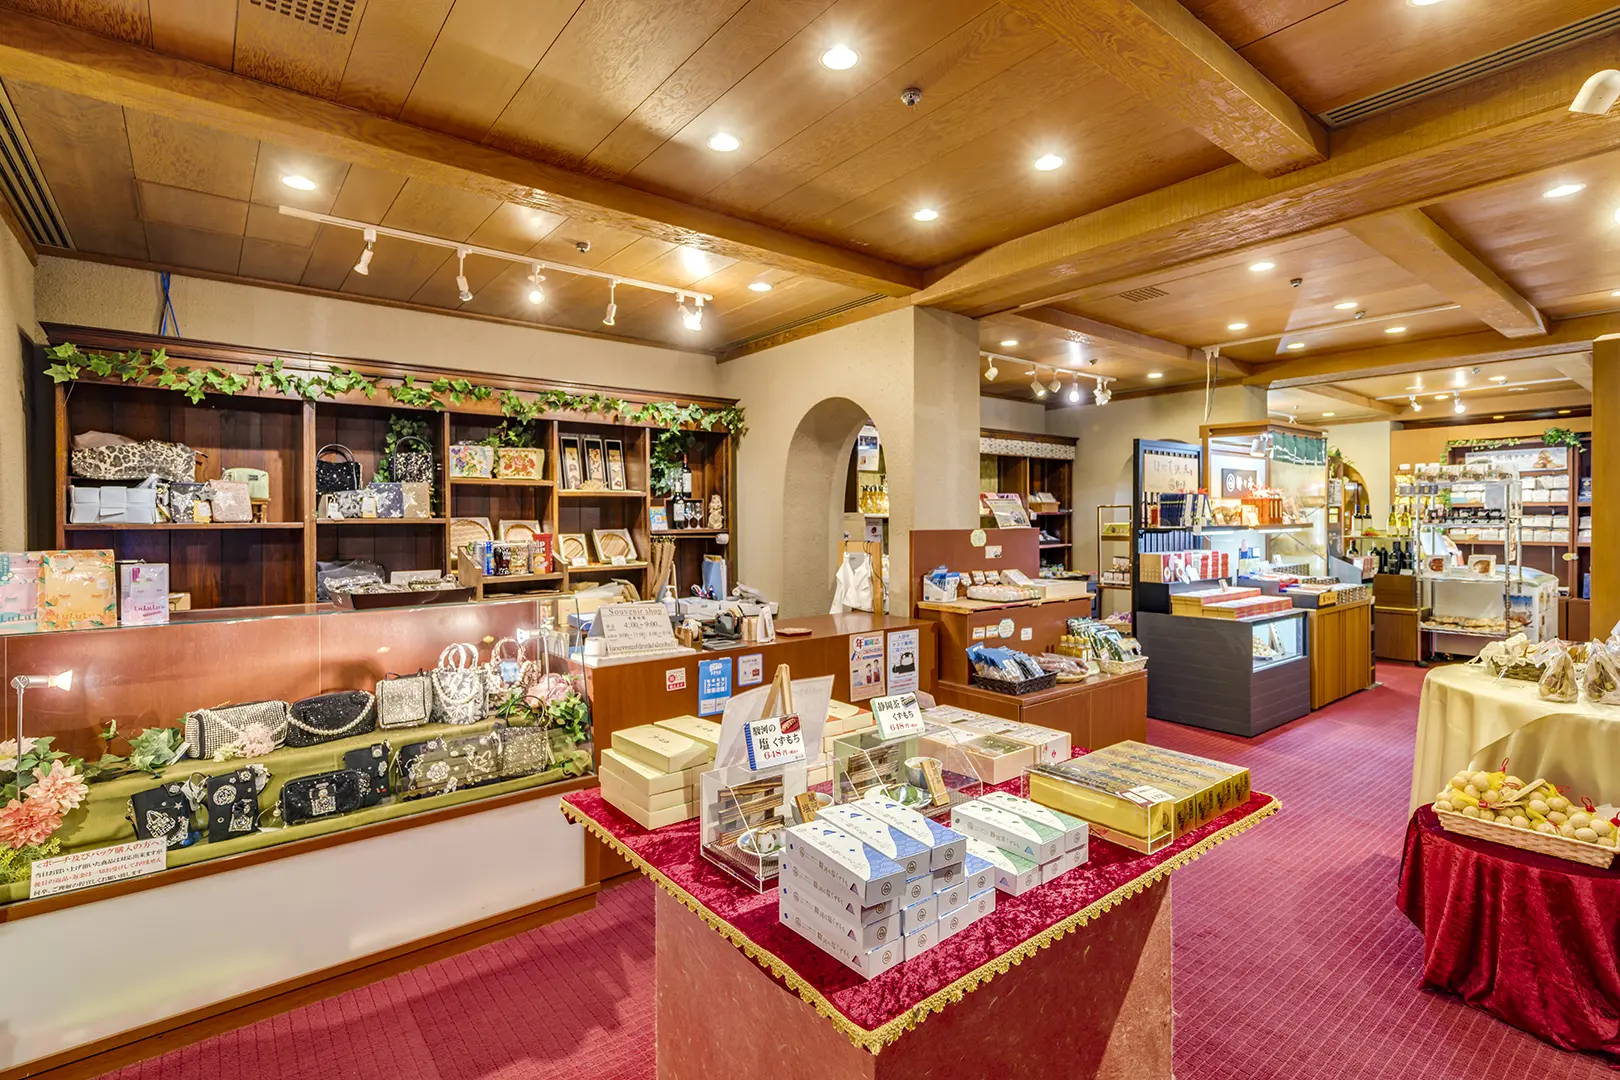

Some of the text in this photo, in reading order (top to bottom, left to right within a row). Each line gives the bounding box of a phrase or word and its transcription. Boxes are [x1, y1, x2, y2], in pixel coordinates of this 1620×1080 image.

[609, 607, 643, 616] Souvenir
[877, 699, 901, 712] 静岡茶
[892, 710, 915, 721] くずもち
[752, 724, 776, 736] 駿河の
[759, 733, 801, 750] 塩 くずもち
